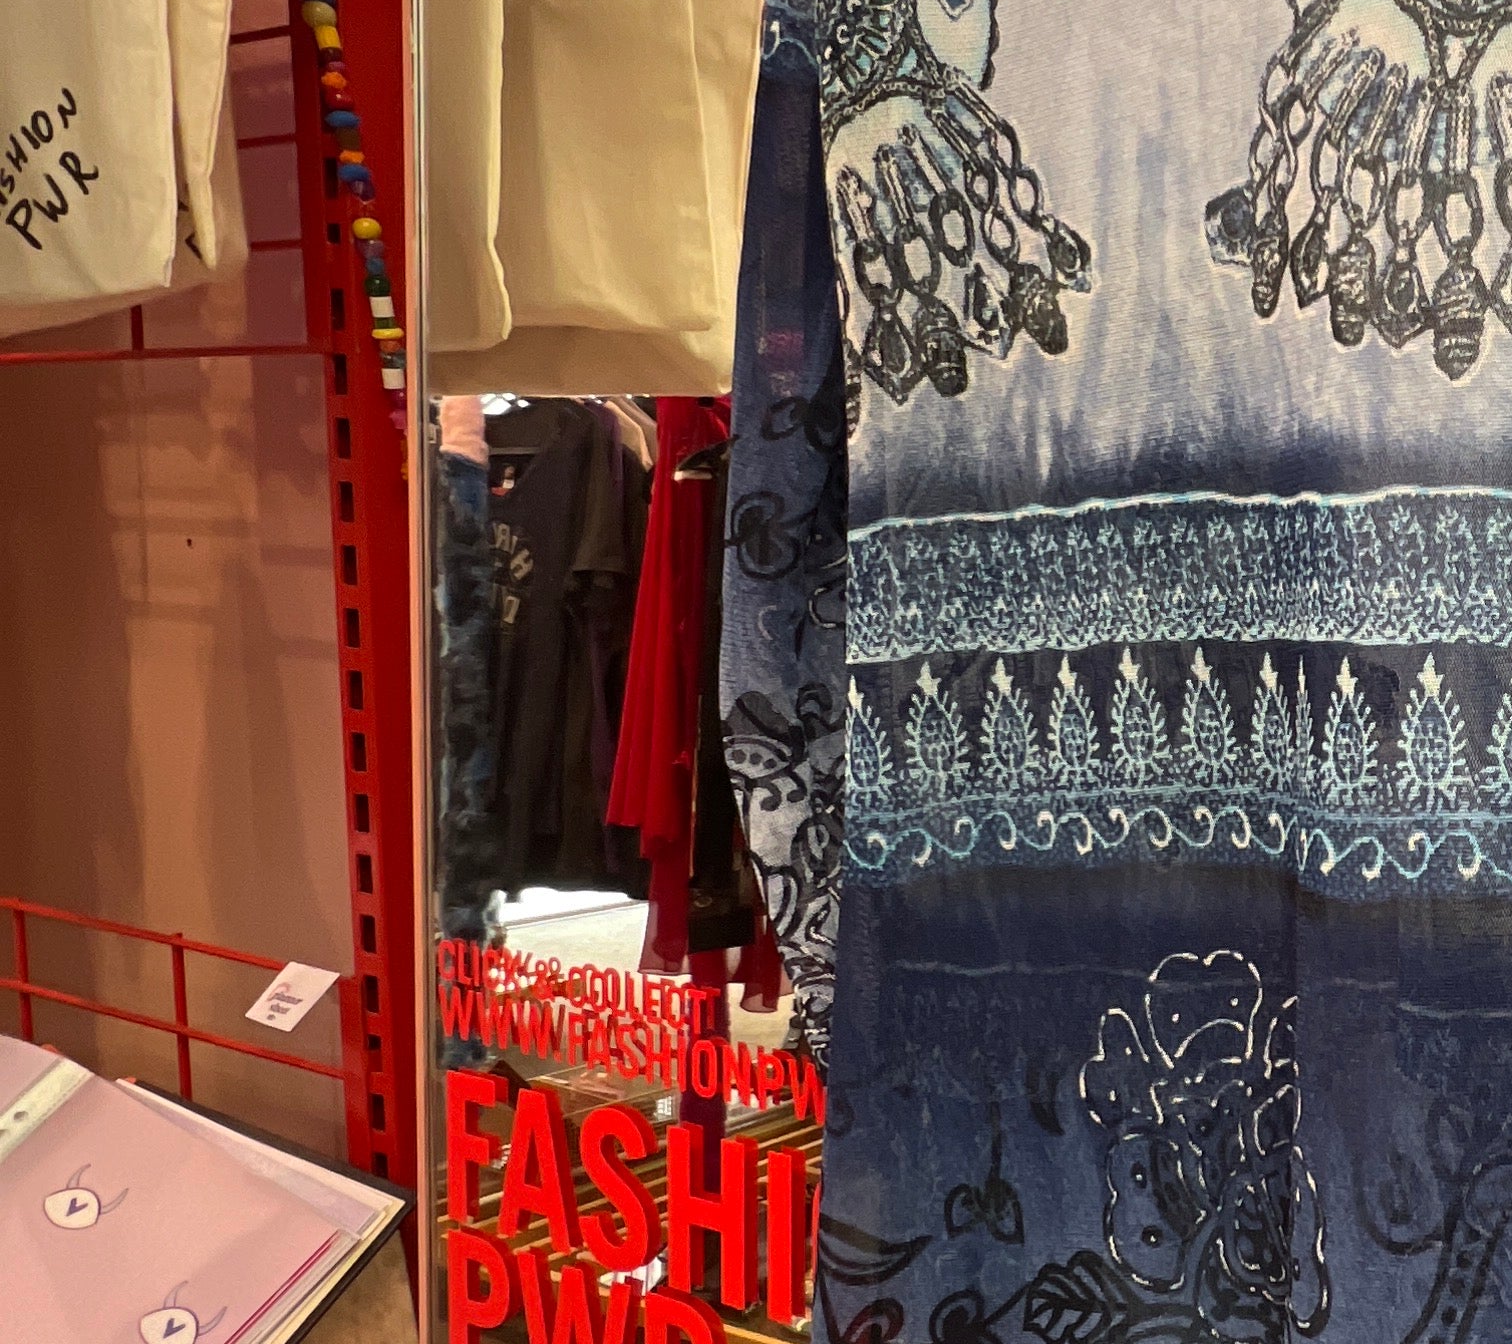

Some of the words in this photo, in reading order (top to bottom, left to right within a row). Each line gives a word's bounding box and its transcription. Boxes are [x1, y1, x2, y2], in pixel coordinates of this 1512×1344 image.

[0, 87, 77, 205] SHION
[6, 151, 99, 250] PWR
[446, 1069, 819, 1324] FASHI
